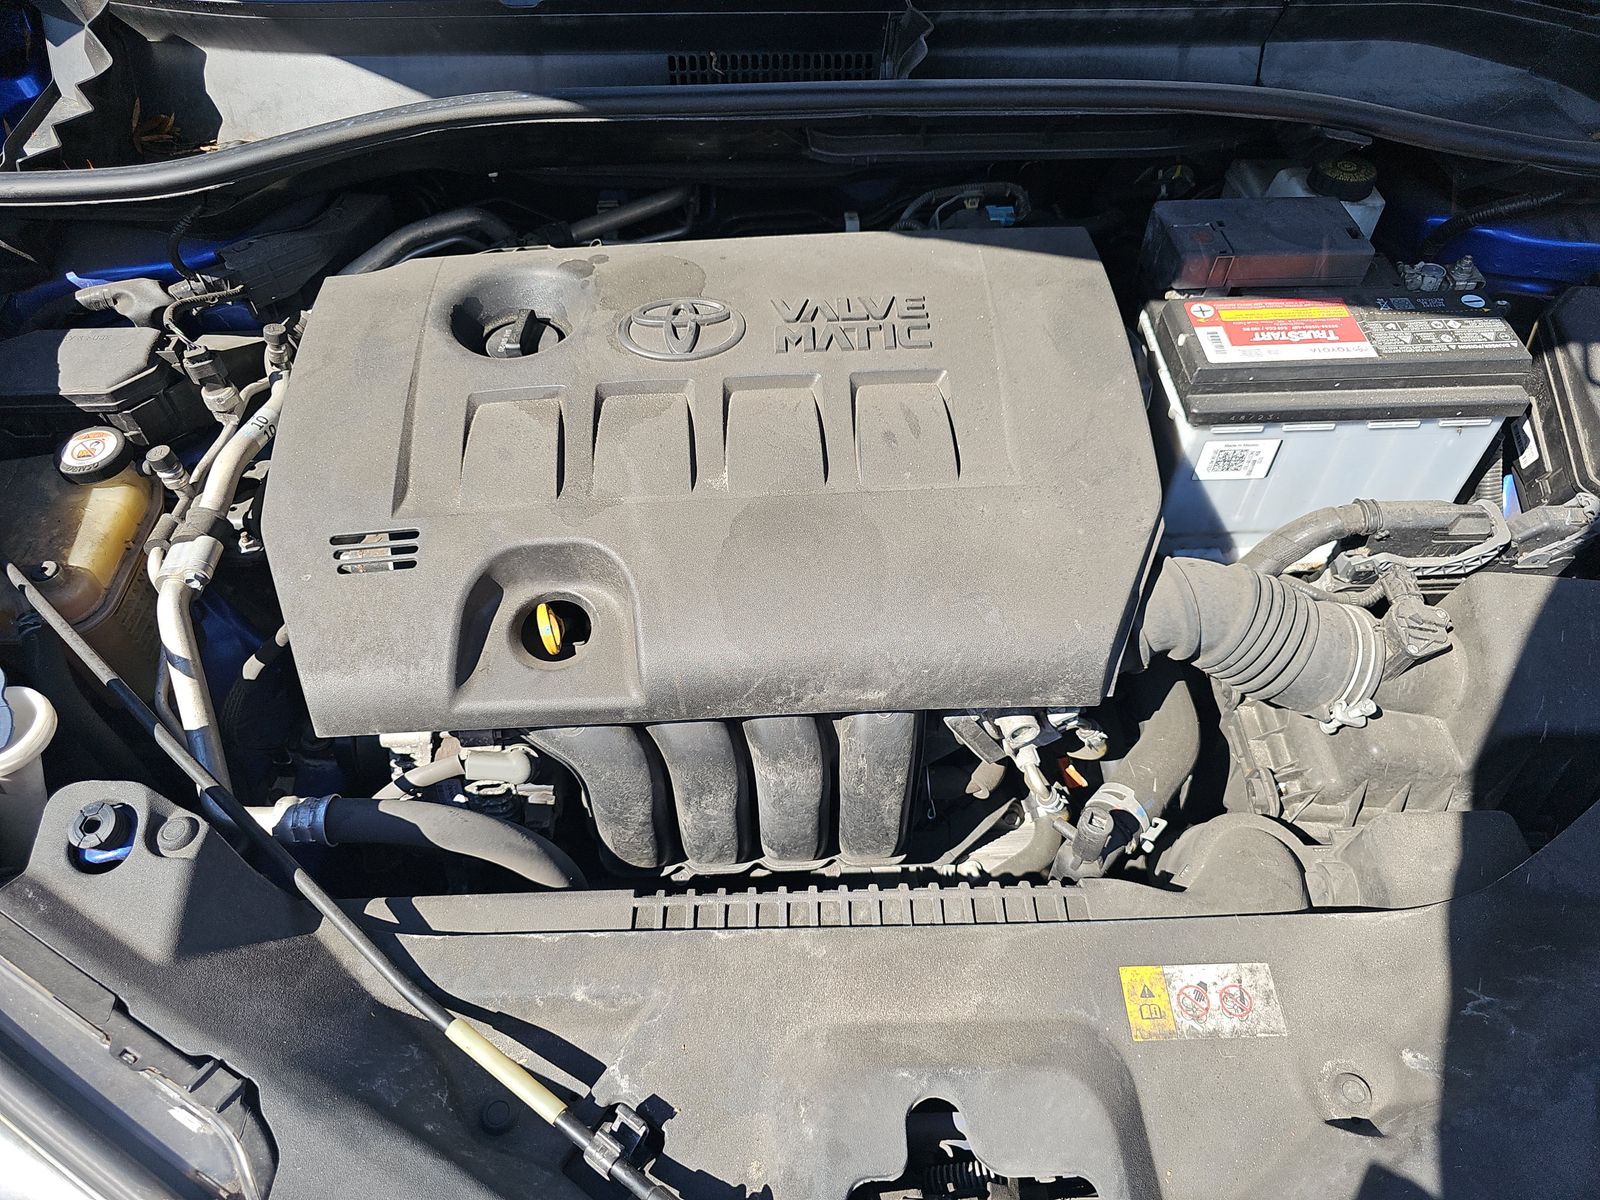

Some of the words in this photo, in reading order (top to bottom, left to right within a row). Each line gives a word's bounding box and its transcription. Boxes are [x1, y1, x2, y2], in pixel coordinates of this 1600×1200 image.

[770, 295, 929, 323] VALVE
[773, 322, 934, 354] MATIC
[251, 415, 269, 431] 10
[263, 424, 277, 442] 10
